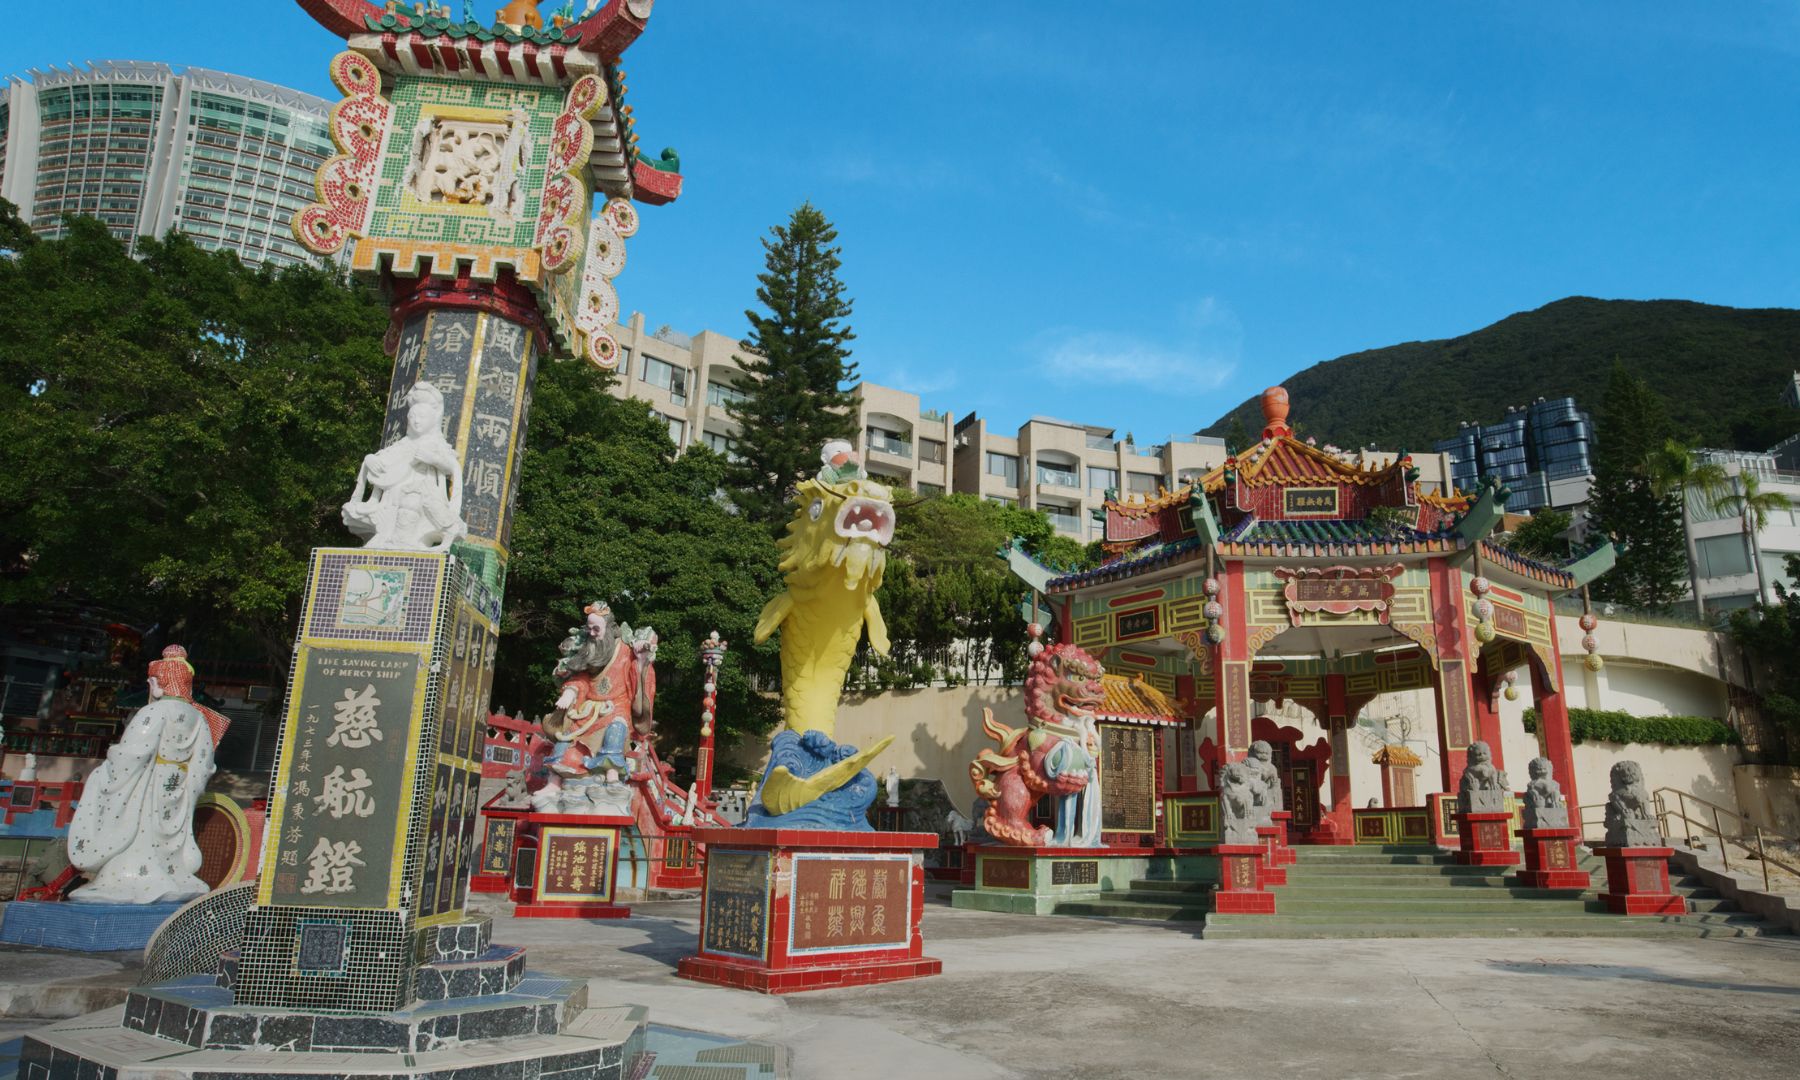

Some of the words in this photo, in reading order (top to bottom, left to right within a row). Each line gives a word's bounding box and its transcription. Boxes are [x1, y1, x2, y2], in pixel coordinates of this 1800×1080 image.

[318, 658, 339, 666] LIFE
[343, 659, 377, 668] SAVING
[380, 661, 409, 669] LAMP
[340, 669, 373, 677] MERCY
[377, 671, 401, 679] SHIP
[462, 629, 481, 720] 吉祥
[427, 775, 447, 872] 如意
